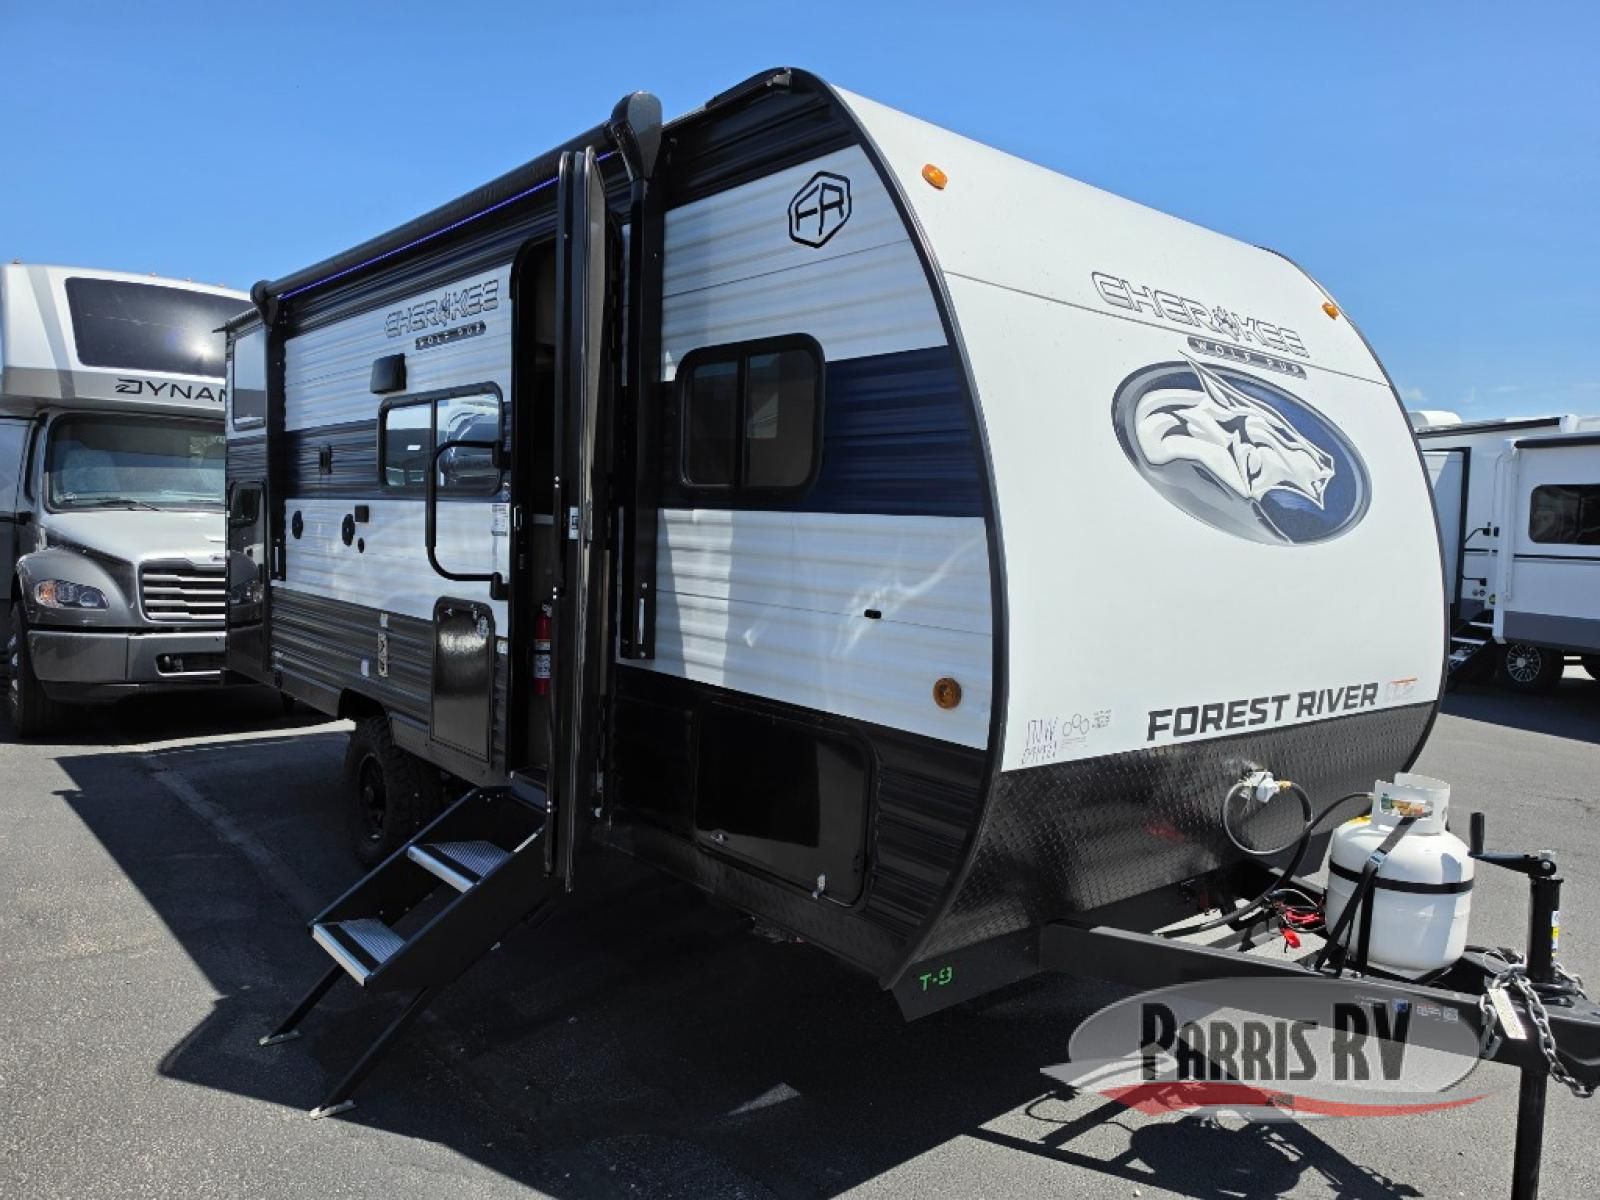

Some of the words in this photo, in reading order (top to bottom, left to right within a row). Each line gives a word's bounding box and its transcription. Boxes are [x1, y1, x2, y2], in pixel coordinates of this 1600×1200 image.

[384, 280, 499, 338] CHEROKEE
[1091, 271, 1310, 358] CHEROKEE
[1194, 339, 1252, 363] WOLF
[1265, 357, 1300, 374] PUP
[1146, 693, 1291, 742] FOREST
[1295, 682, 1379, 718] RIVER
